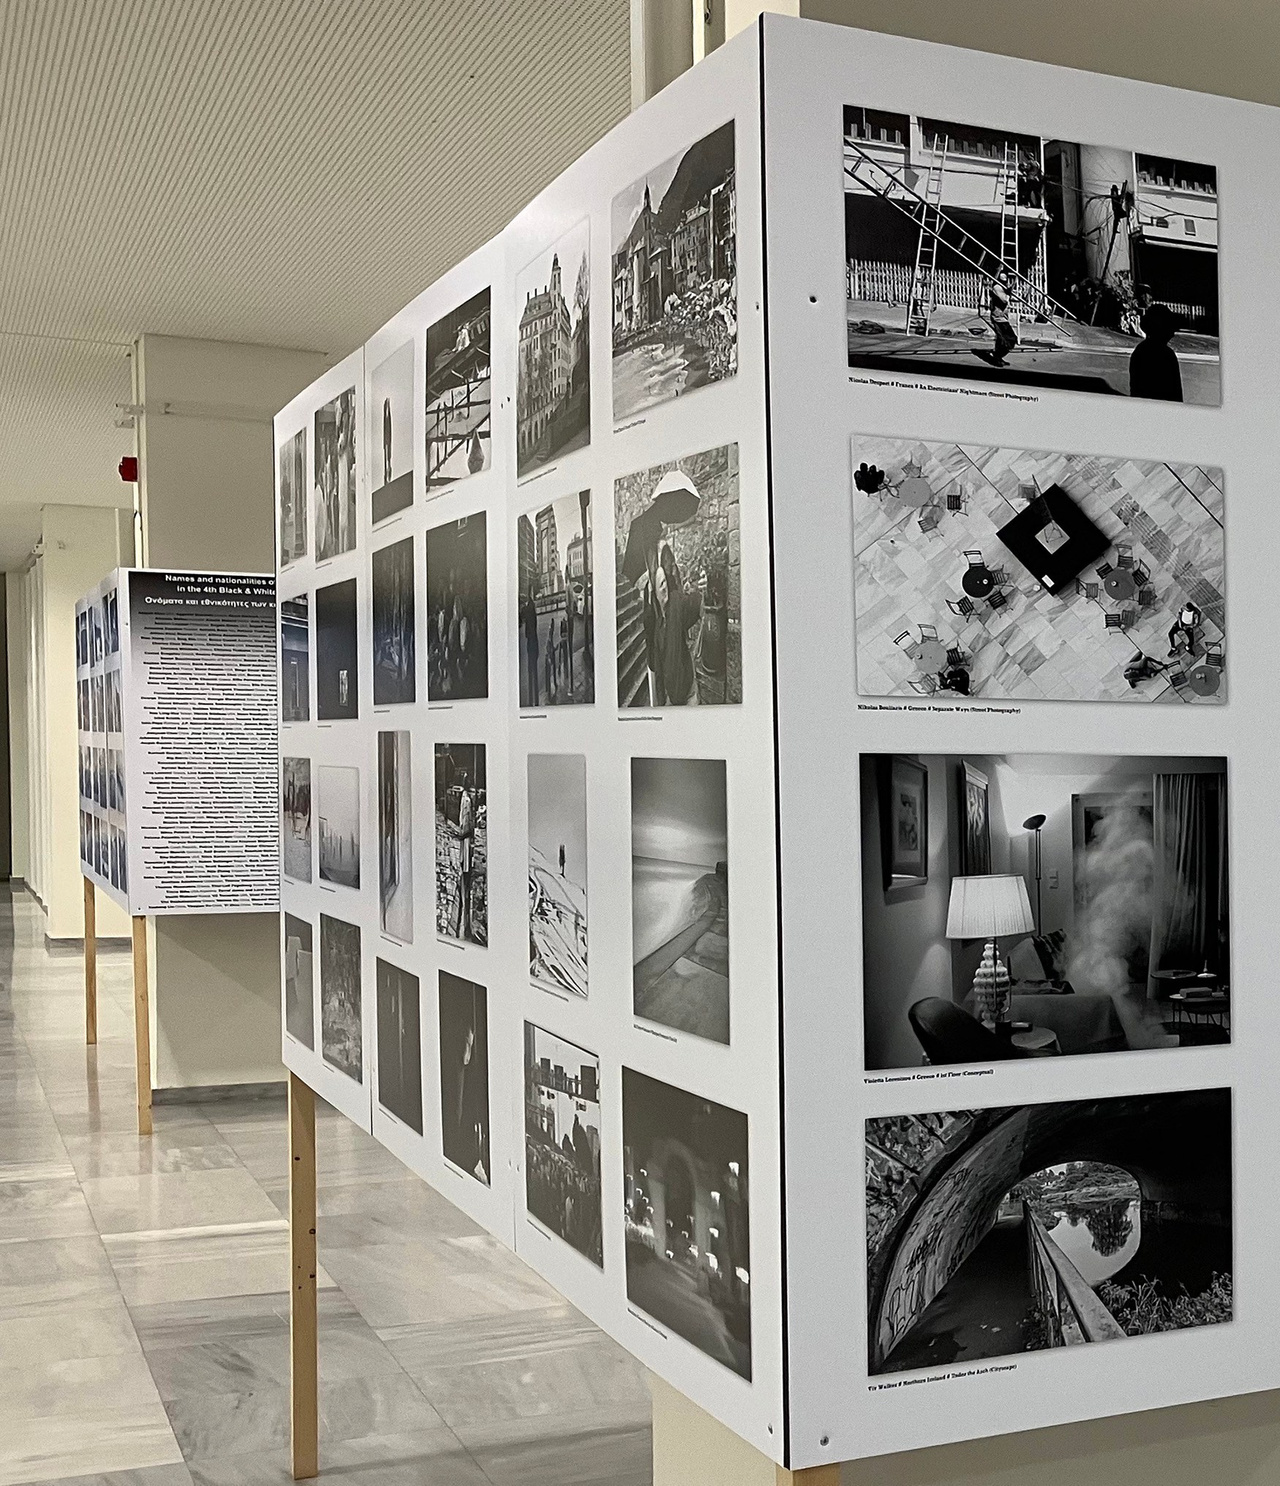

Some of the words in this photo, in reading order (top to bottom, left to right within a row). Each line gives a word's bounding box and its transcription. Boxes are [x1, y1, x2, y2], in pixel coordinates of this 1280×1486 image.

[215, 577, 267, 585] nationalities
[187, 585, 201, 593] the
[145, 596, 183, 605] Ονόματα
[200, 599, 249, 608] εθνικότητες
